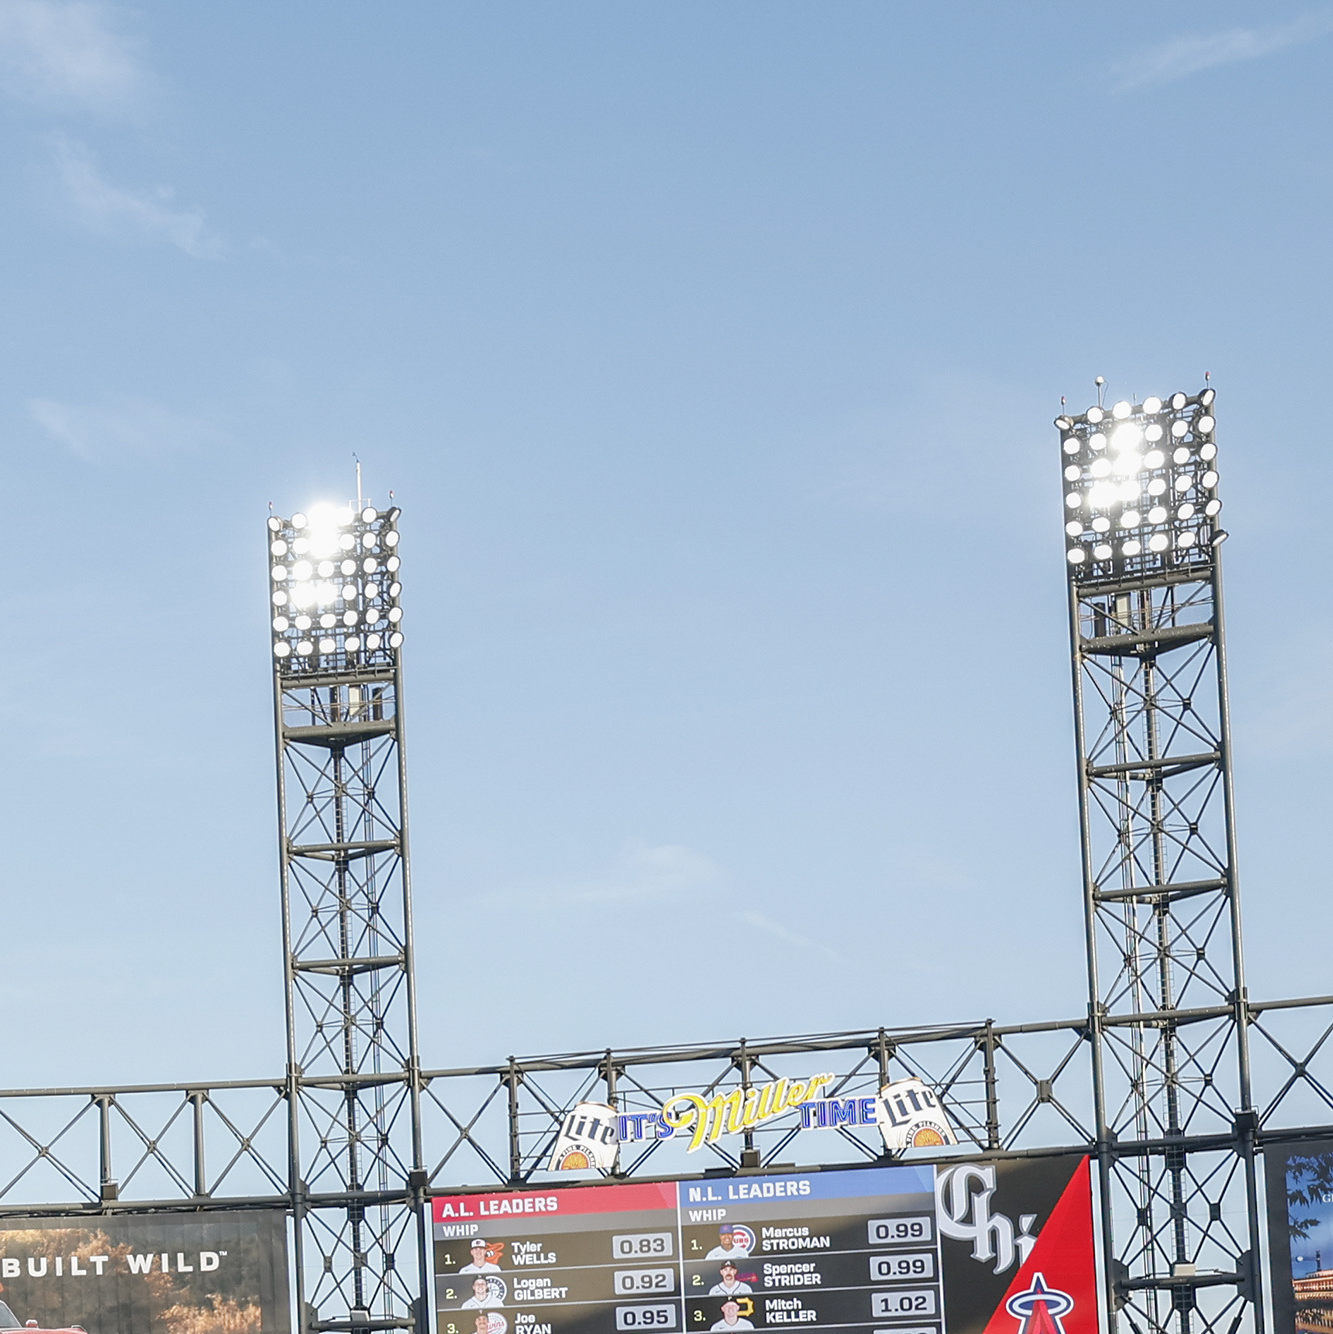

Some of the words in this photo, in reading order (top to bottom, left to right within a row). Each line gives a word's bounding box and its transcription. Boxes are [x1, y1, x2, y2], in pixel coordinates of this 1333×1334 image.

[618, 1112, 675, 1140] IT'S
[798, 1097, 878, 1129] TIME
[662, 1072, 836, 1154] Miller
[882, 1088, 937, 1128] Lite
[563, 1114, 615, 1146] Lite
[689, 1186, 723, 1202] N.L.
[728, 1180, 811, 1200] LEADERS
[442, 1202, 474, 1218] A.L.
[479, 1197, 558, 1216] LEADERS
[689, 1208, 726, 1222] WHIP
[443, 1224, 479, 1237] WHIP
[691, 1239, 703, 1250] 1.
[761, 1226, 809, 1239] Marcus
[875, 1222, 924, 1239] 0.99
[444, 1254, 456, 1265] 1.
[511, 1242, 542, 1254] Tyler
[620, 1237, 666, 1255] 0.83
[761, 1236, 831, 1251] STROMAN
[2, 1254, 109, 1278] BUILT
[126, 1251, 219, 1275] WILD
[511, 1252, 557, 1266] WELLS
[692, 1275, 704, 1285] 2.
[763, 1262, 816, 1276] Spencer
[877, 1258, 925, 1276] 0.99
[763, 1273, 821, 1288] STRIDER
[445, 1289, 457, 1299] 2.
[513, 1277, 551, 1290] Logan
[621, 1274, 667, 1290] 0.92
[513, 1287, 568, 1301] GILBERT
[694, 1311, 706, 1321] 3.
[765, 1298, 802, 1310] Mitch
[880, 1295, 928, 1313] 1.02
[766, 1310, 817, 1324] KELLER
[447, 1324, 459, 1334] 3.
[514, 1312, 536, 1325] Joe
[623, 1310, 669, 1326] 0.95
